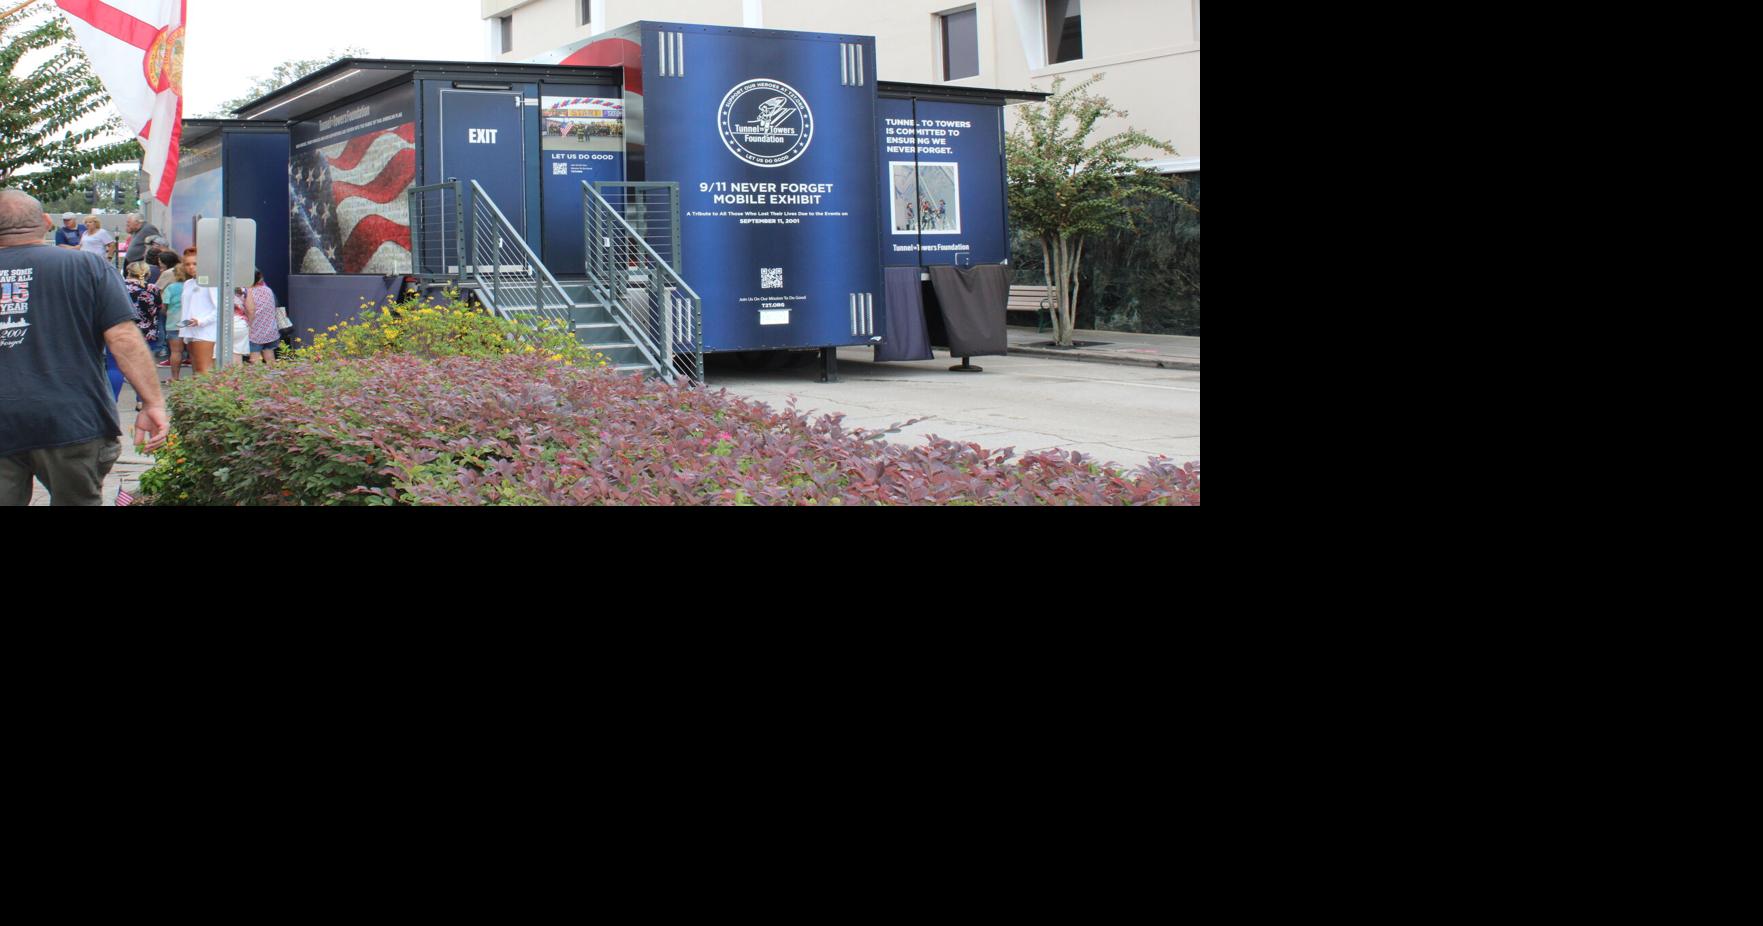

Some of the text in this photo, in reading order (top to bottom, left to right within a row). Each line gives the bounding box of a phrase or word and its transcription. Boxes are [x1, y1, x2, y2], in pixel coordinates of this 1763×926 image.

[725, 88, 744, 107] SUPPORT
[743, 83, 756, 91] OUR
[756, 82, 780, 90] HEROES
[921, 119, 934, 127] TO
[935, 120, 972, 128] TOWERS
[735, 124, 760, 133] Tunnel
[770, 125, 795, 133] Towers
[468, 128, 498, 144] EXIT
[744, 134, 785, 143] Foundation
[886, 136, 930, 145] ENSURNG
[886, 145, 953, 154] NEVER FORGET.
[745, 153, 756, 161] LET
[773, 154, 789, 163] GOOD
[699, 182, 834, 193] 9/11 NEVER FORGET
[713, 194, 822, 205] MOBILE EXHIBIT
[892, 243, 914, 252] Tunnel
[937, 243, 970, 251] Foundation
[11, 268, 33, 276] SOME
[0, 303, 28, 312] YEAR
[1, 328, 28, 338] 2001
